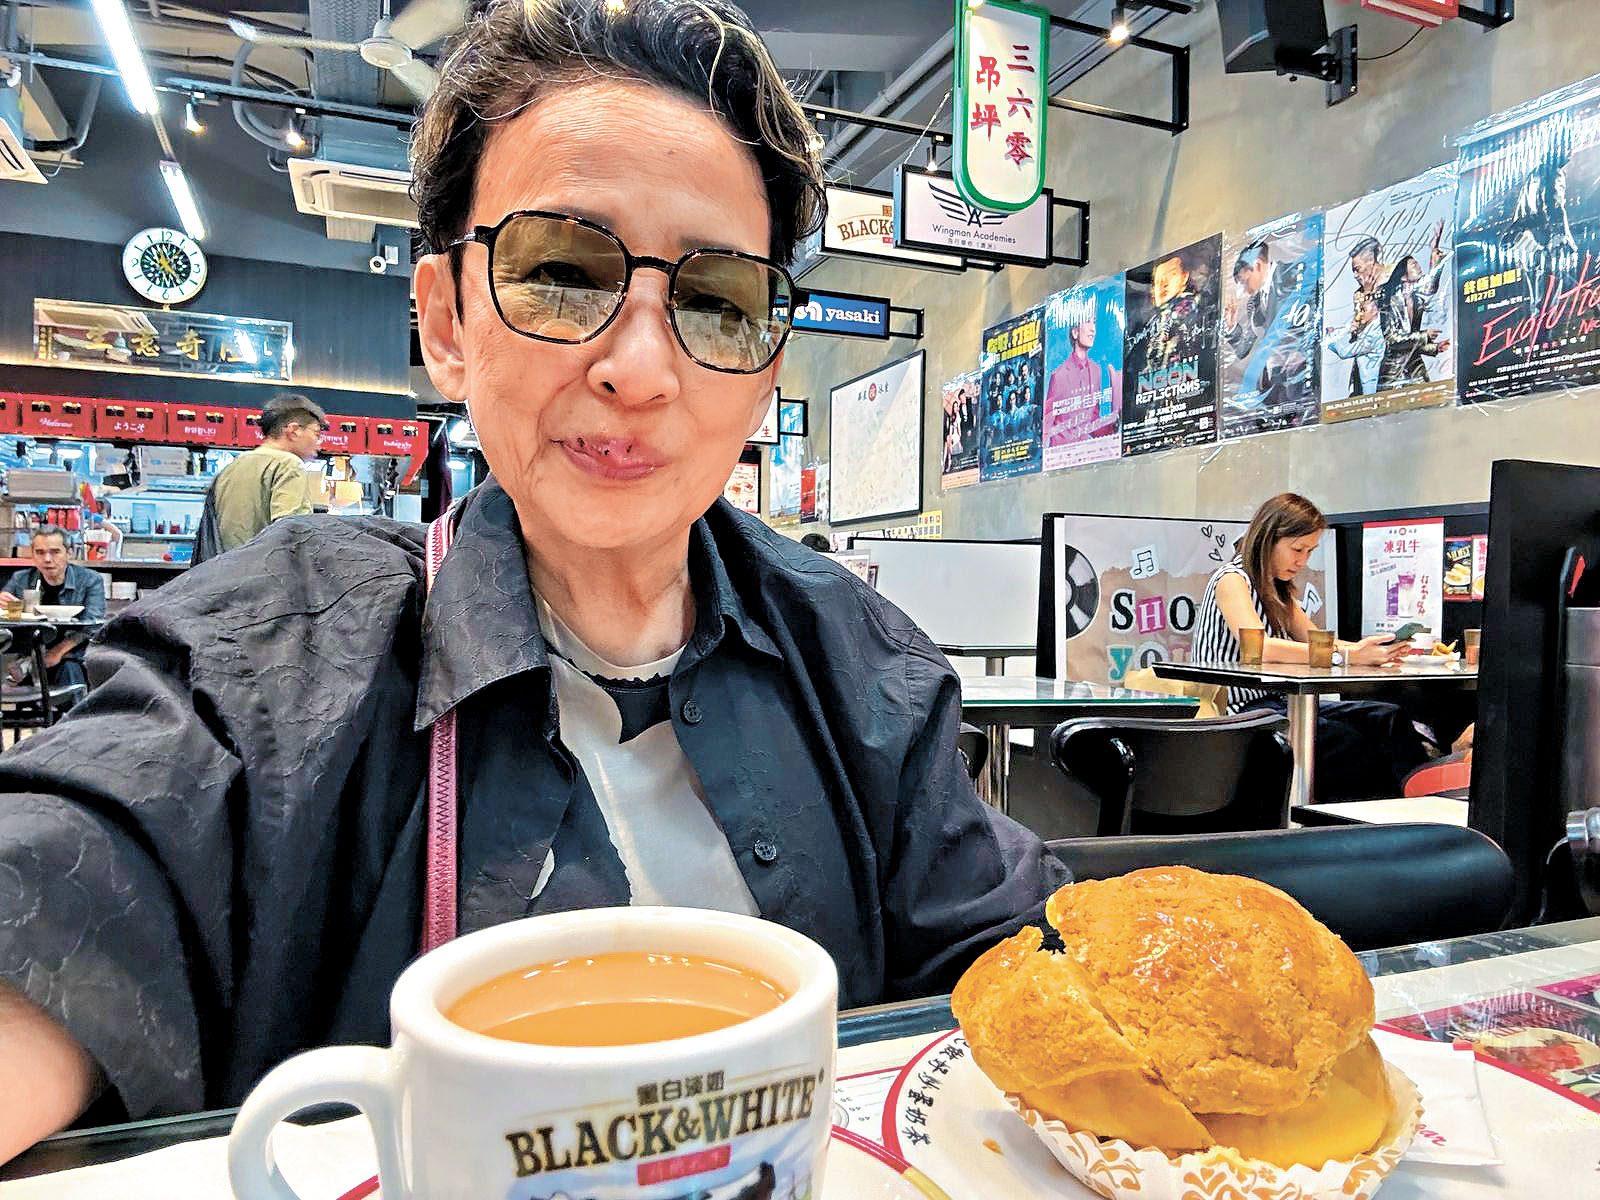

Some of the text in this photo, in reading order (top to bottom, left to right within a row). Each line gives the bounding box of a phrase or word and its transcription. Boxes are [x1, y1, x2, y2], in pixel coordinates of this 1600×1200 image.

[970, 55, 1002, 142] 昂坪
[1006, 44, 1035, 171] 三六零
[161, 230, 173, 243] 12
[932, 223, 1016, 244] Wingman Academies
[824, 307, 881, 324] yasaki
[1111, 592, 1199, 633] SHO
[506, 1073, 816, 1179] BLACK&WHITE
